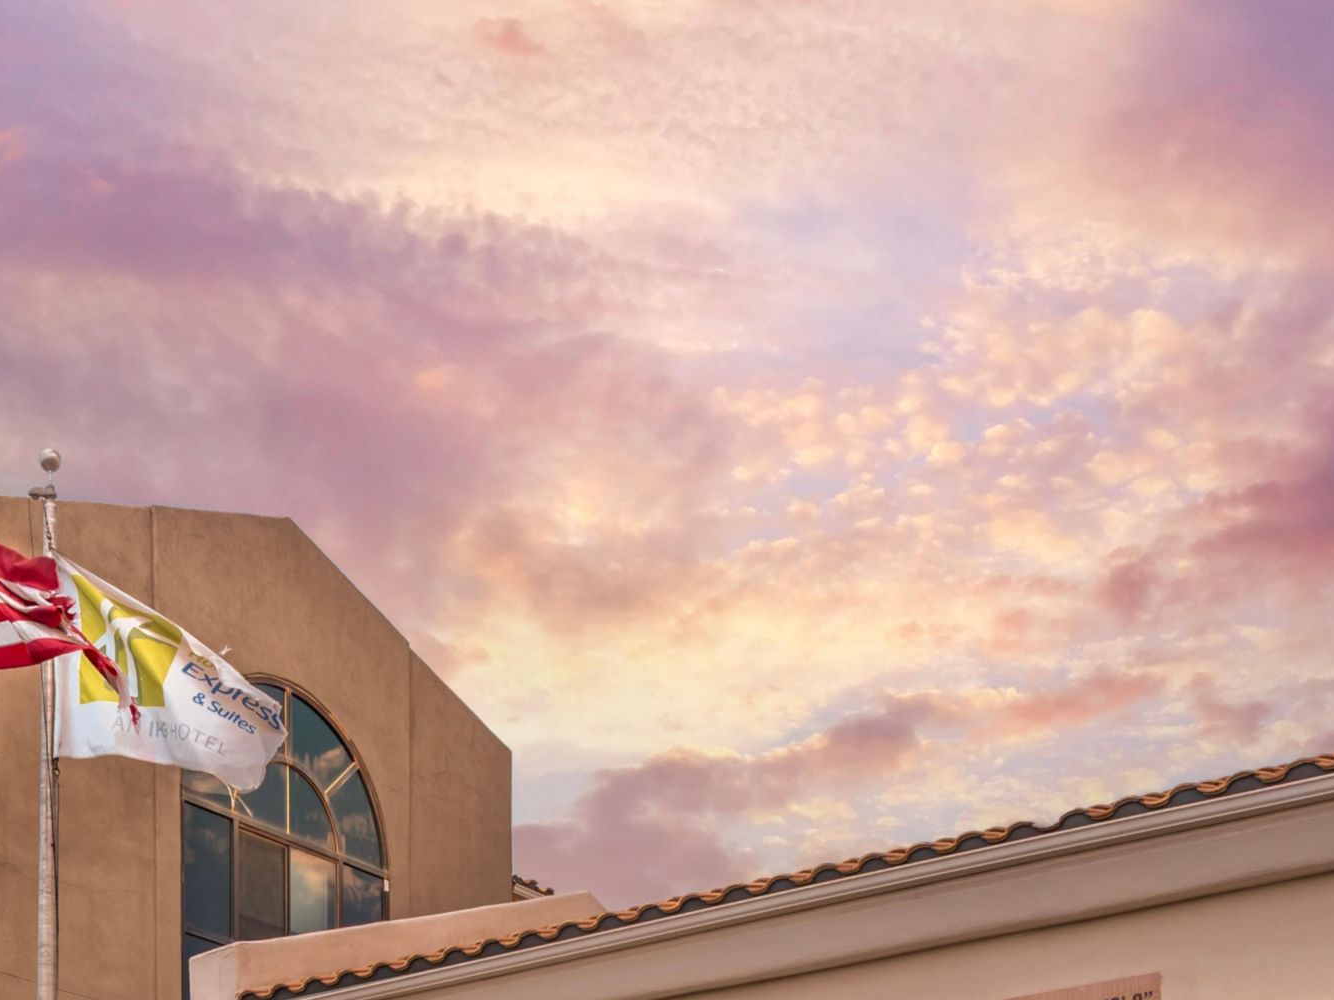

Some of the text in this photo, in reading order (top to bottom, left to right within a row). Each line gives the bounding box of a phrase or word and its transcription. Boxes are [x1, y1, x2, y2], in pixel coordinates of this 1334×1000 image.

[181, 661, 283, 730] Express
[192, 692, 257, 735] & Suites
[170, 722, 227, 758] HOTEL
